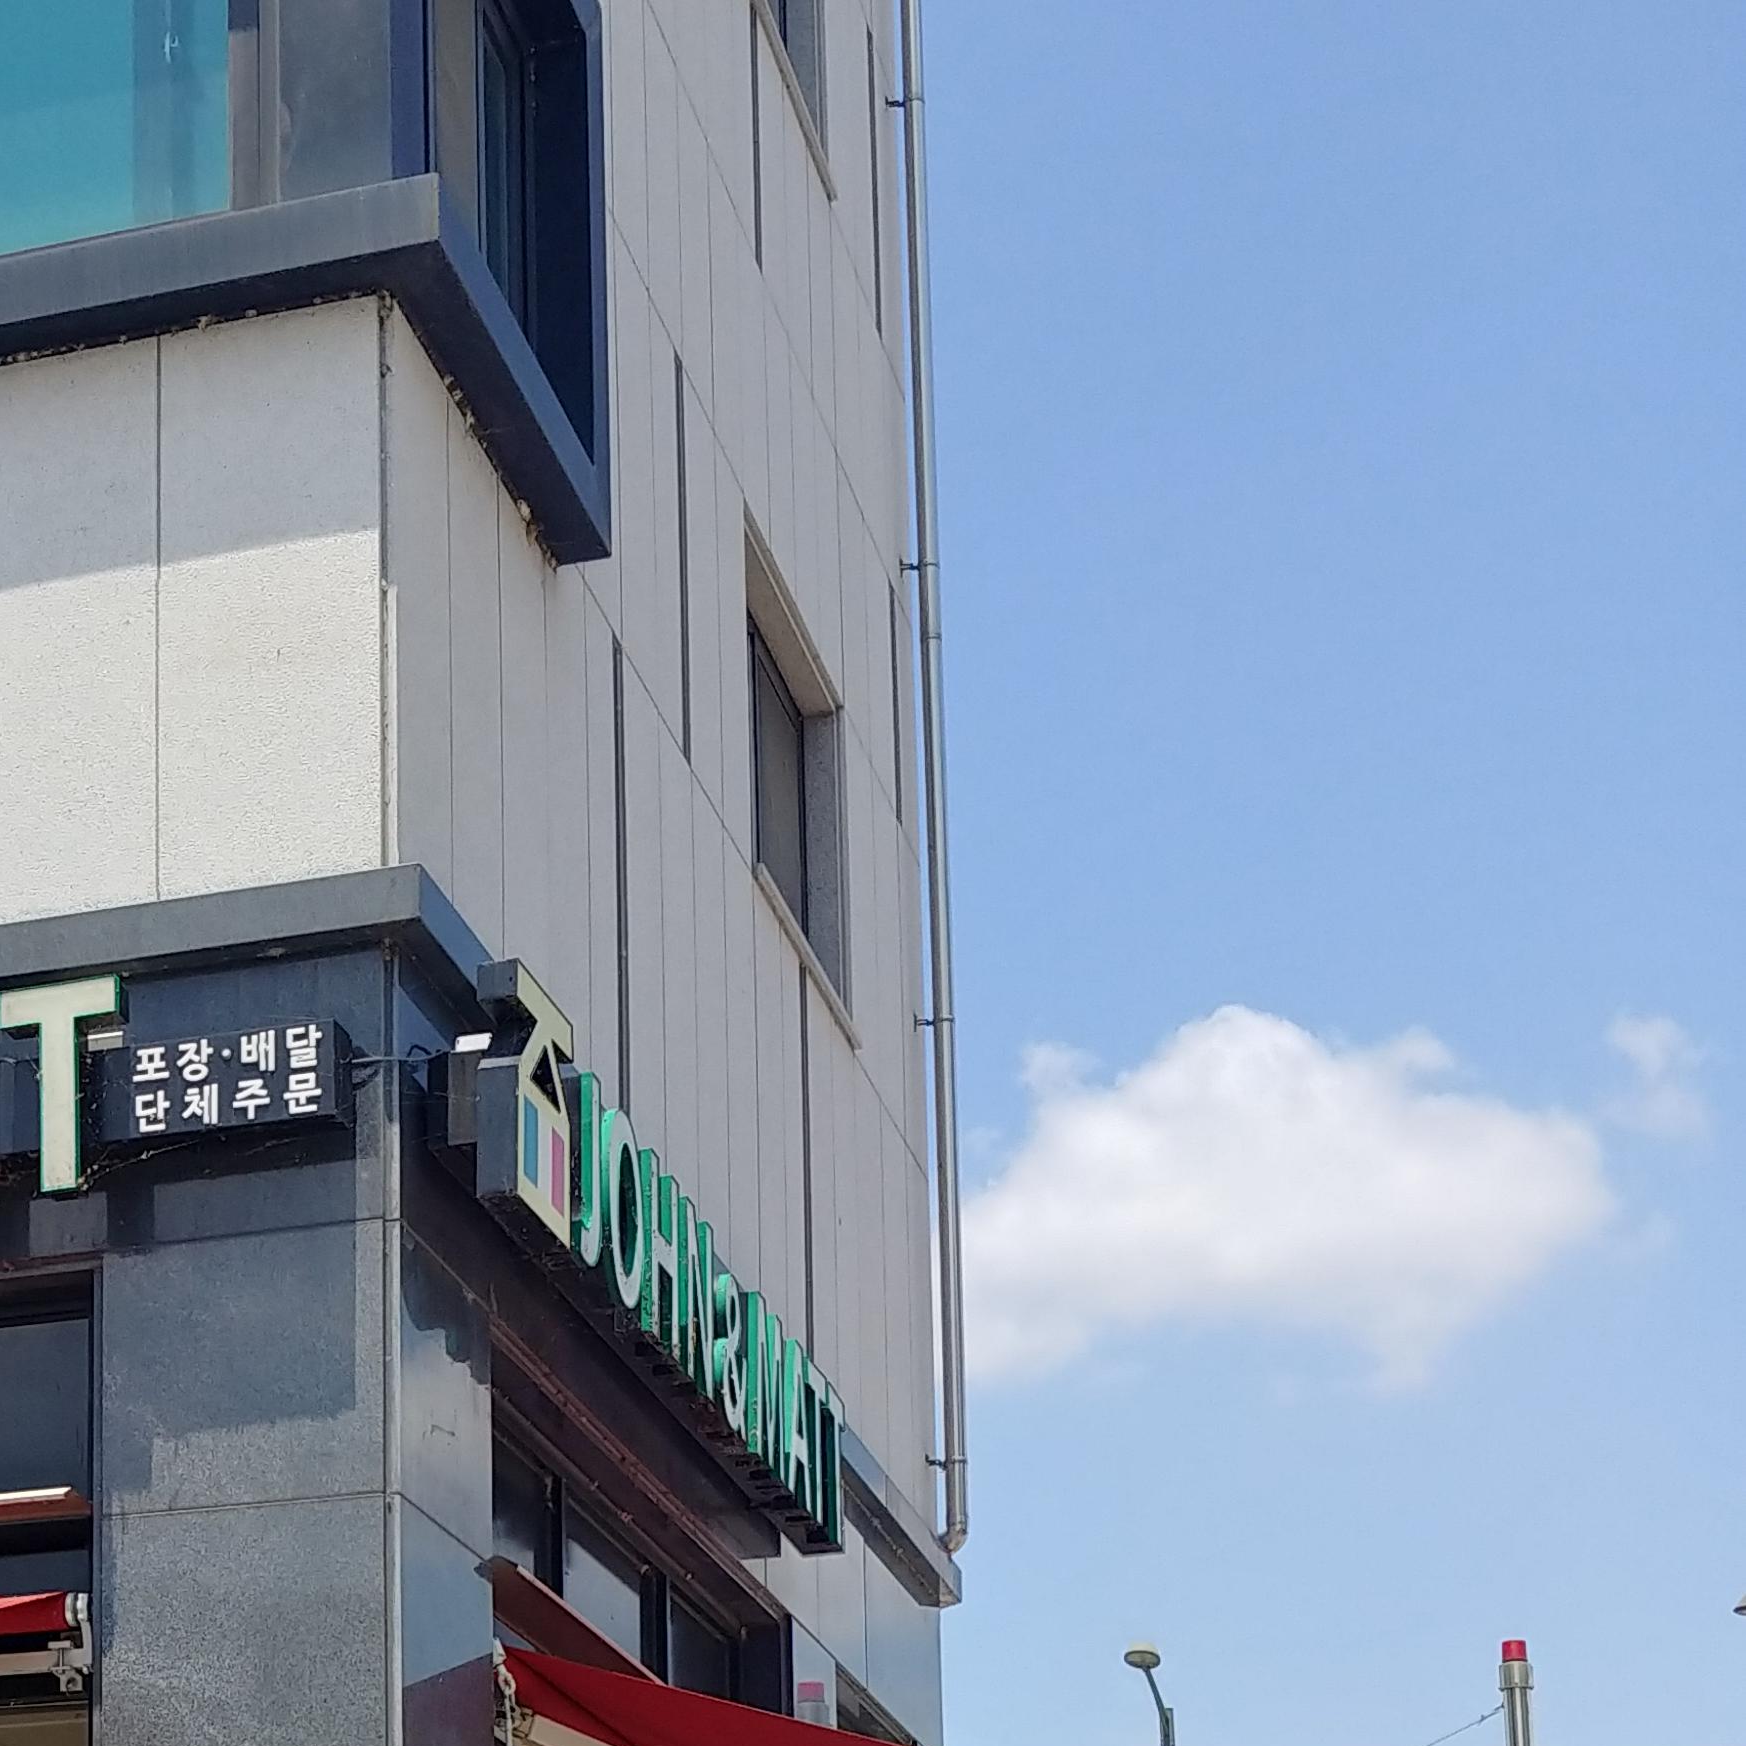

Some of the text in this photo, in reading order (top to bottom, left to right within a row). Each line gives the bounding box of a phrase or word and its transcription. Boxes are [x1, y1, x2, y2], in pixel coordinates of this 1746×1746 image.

[132, 1024, 323, 1082] 포장·배달
[135, 1071, 323, 1133] 단체주문
[576, 1071, 714, 1400] JOHN
[747, 1290, 845, 1551] MATT
